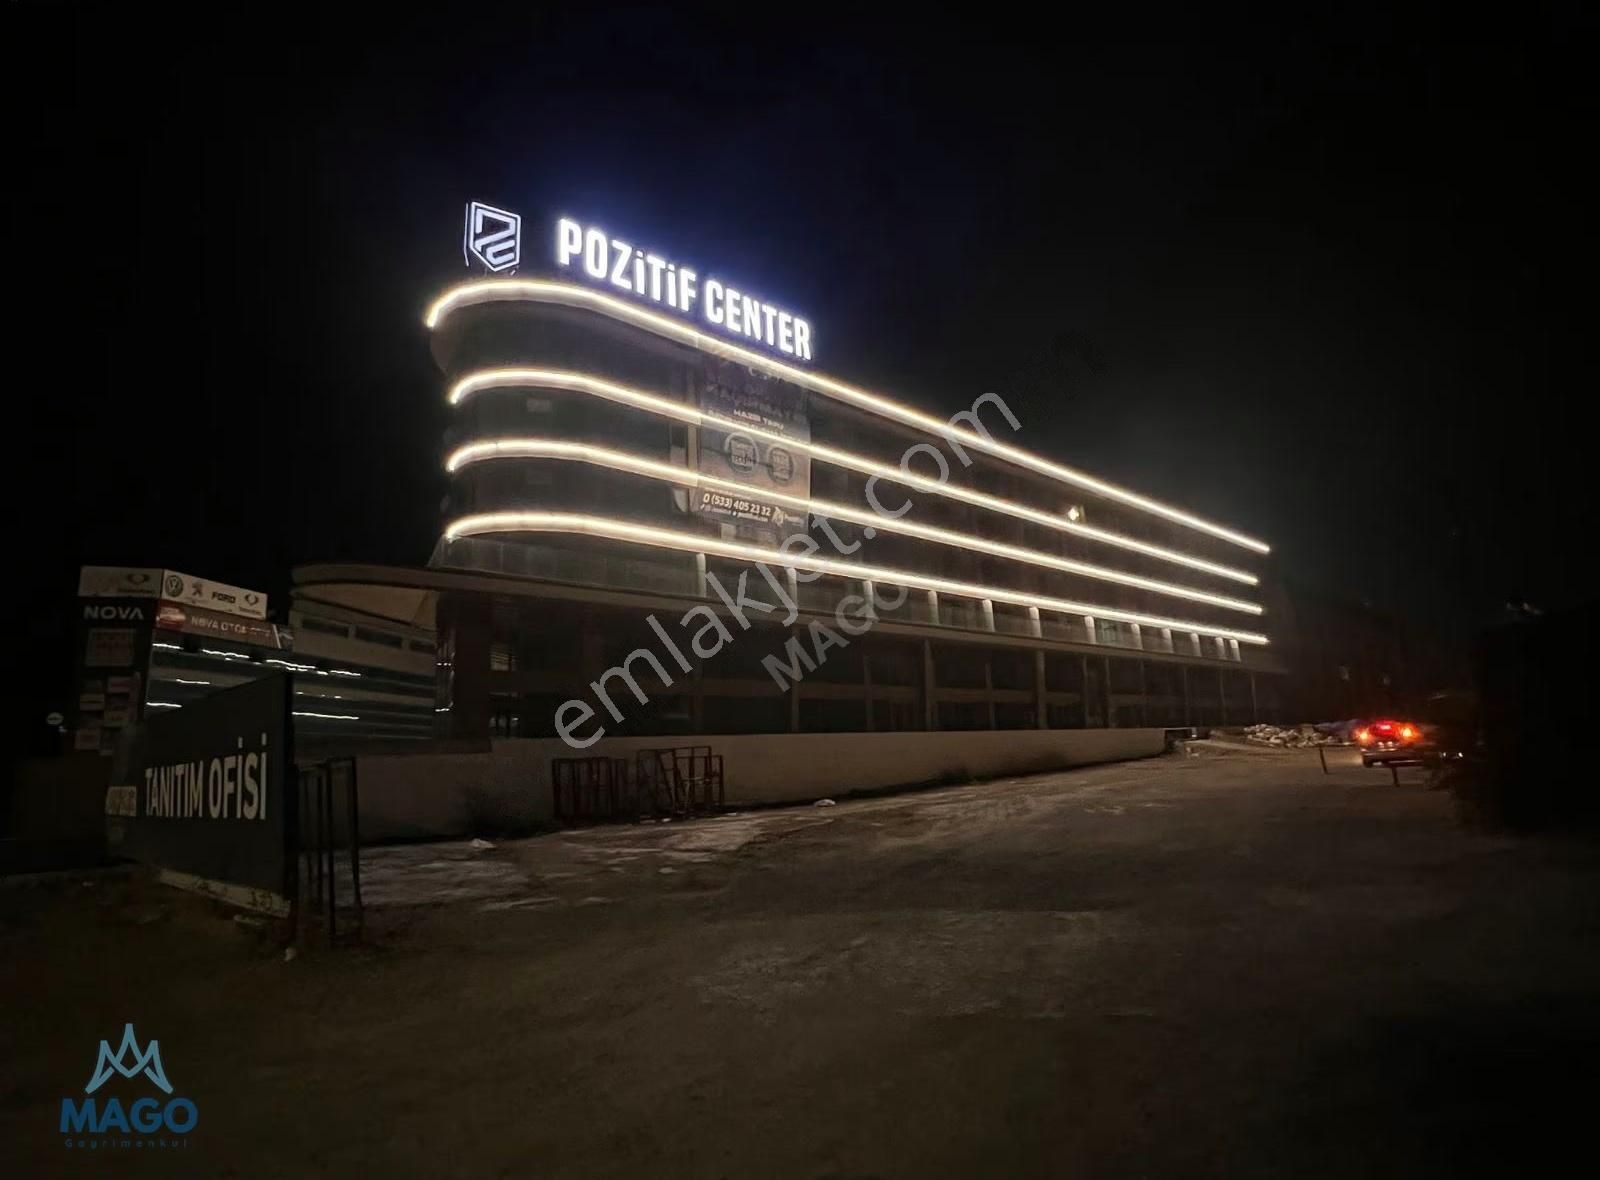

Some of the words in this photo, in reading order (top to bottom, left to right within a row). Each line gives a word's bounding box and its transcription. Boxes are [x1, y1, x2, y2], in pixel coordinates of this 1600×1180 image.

[704, 277, 813, 362] CENTER
[703, 493, 710, 503] 0
[711, 494, 733, 509] (533)
[733, 500, 750, 511] 405
[211, 591, 236, 604] FORD
[84, 605, 144, 620] NOVA
[191, 615, 219, 629] NOVA
[143, 760, 204, 819] TANITIM
[208, 731, 268, 821] OFİSİ
